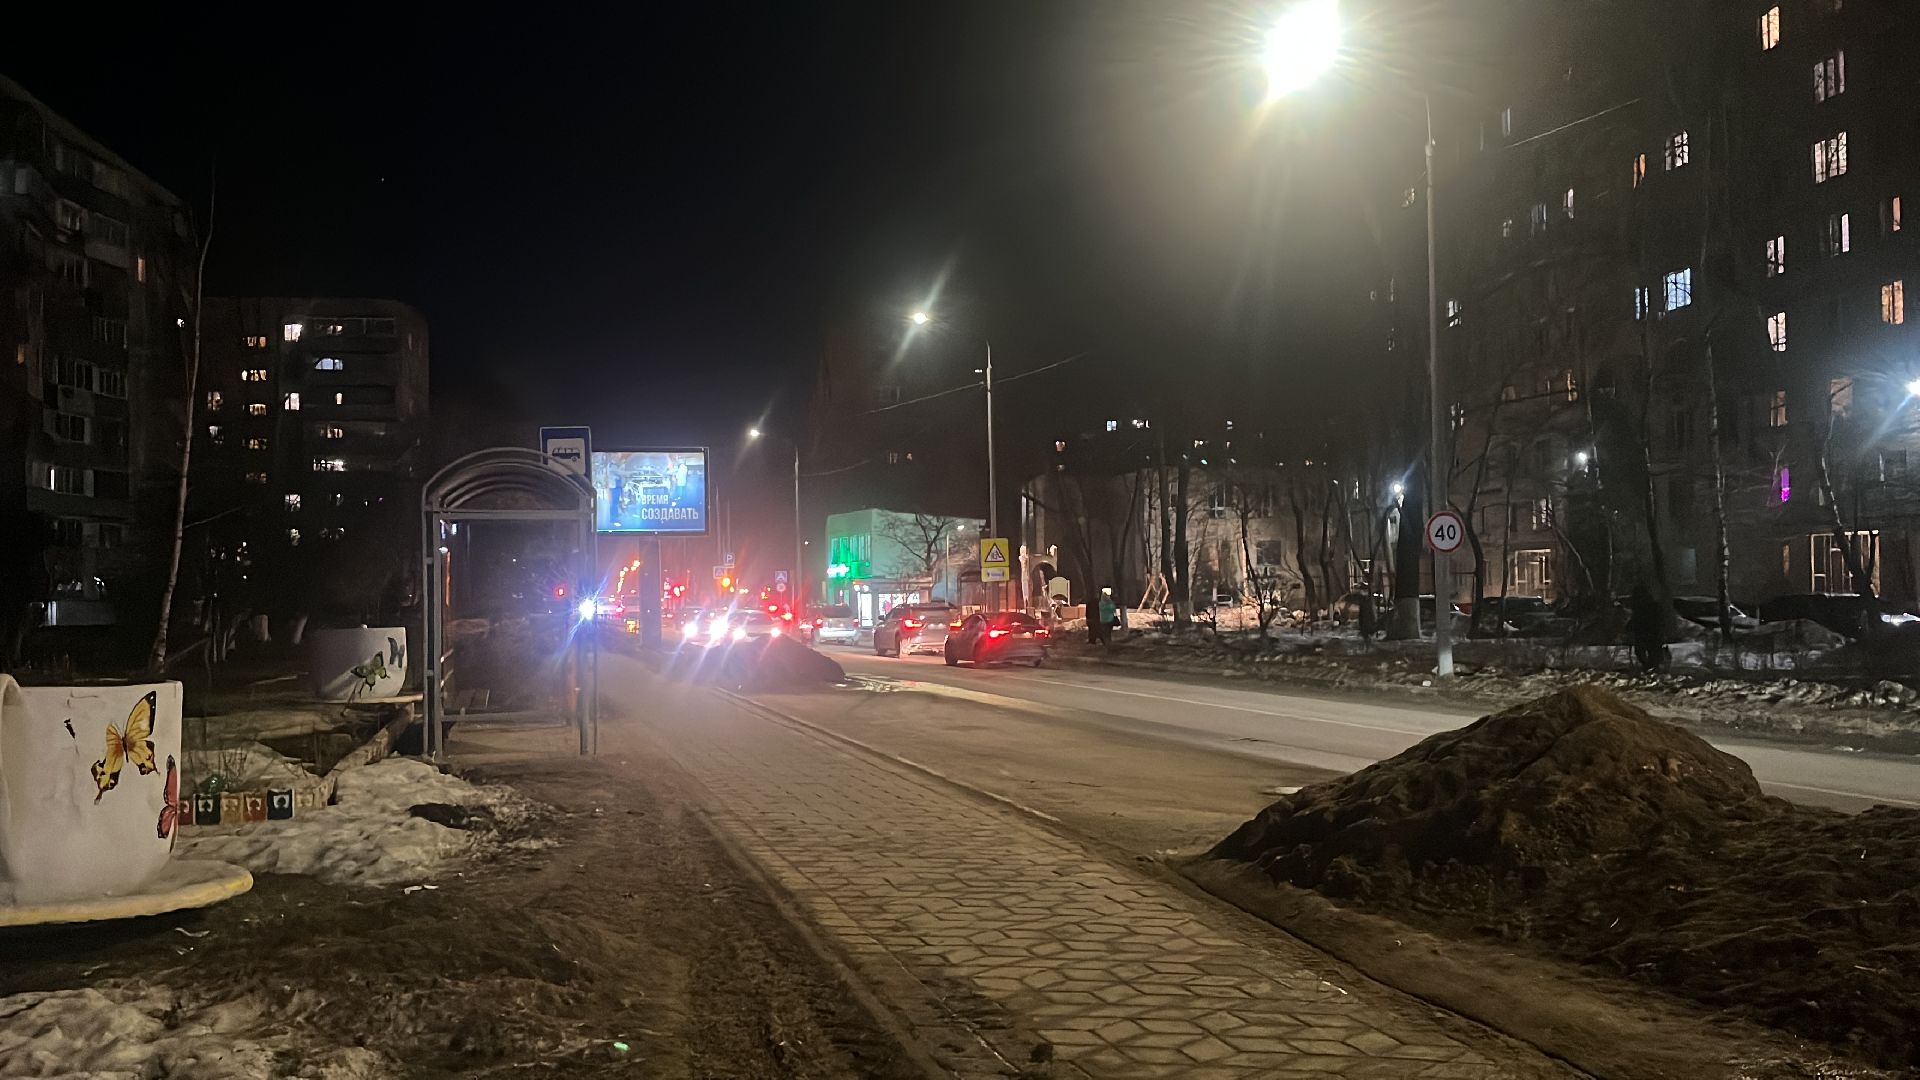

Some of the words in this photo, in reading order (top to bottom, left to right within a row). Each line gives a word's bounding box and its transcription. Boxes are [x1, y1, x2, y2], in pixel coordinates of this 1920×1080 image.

[642, 494, 669, 505] ВРЕМЯ
[641, 507, 699, 520] СОЗДАВАТЬ
[1435, 524, 1456, 541] 40
